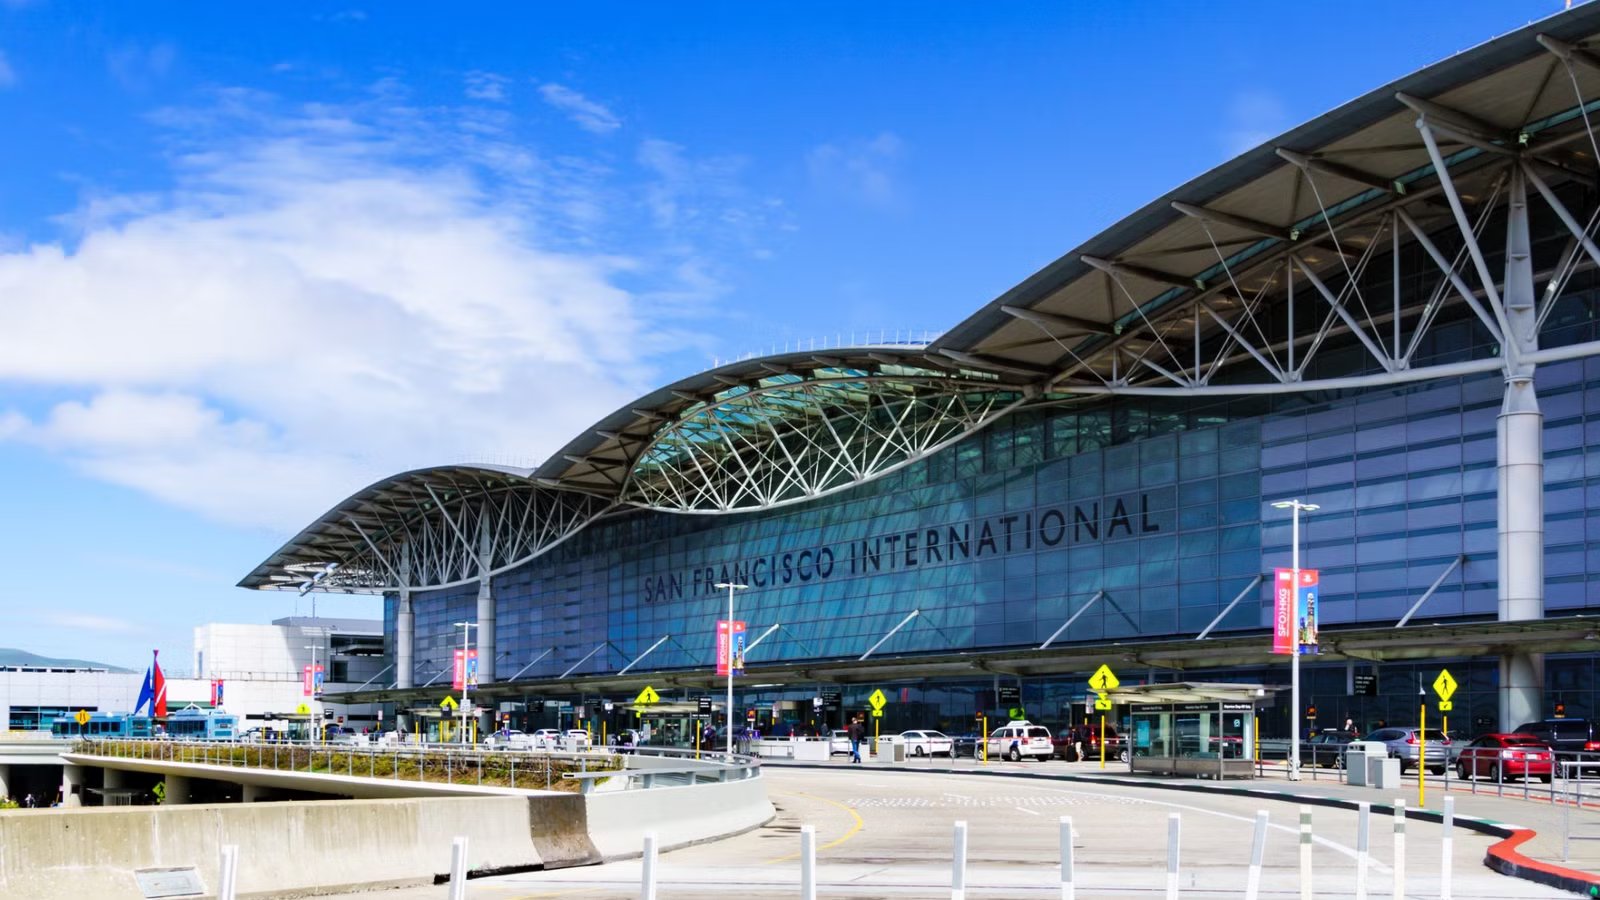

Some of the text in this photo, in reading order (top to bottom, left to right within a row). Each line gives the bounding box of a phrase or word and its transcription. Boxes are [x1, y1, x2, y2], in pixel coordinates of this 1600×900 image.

[644, 493, 1160, 601] SAN FRANCISCO INTERNATIONAL
